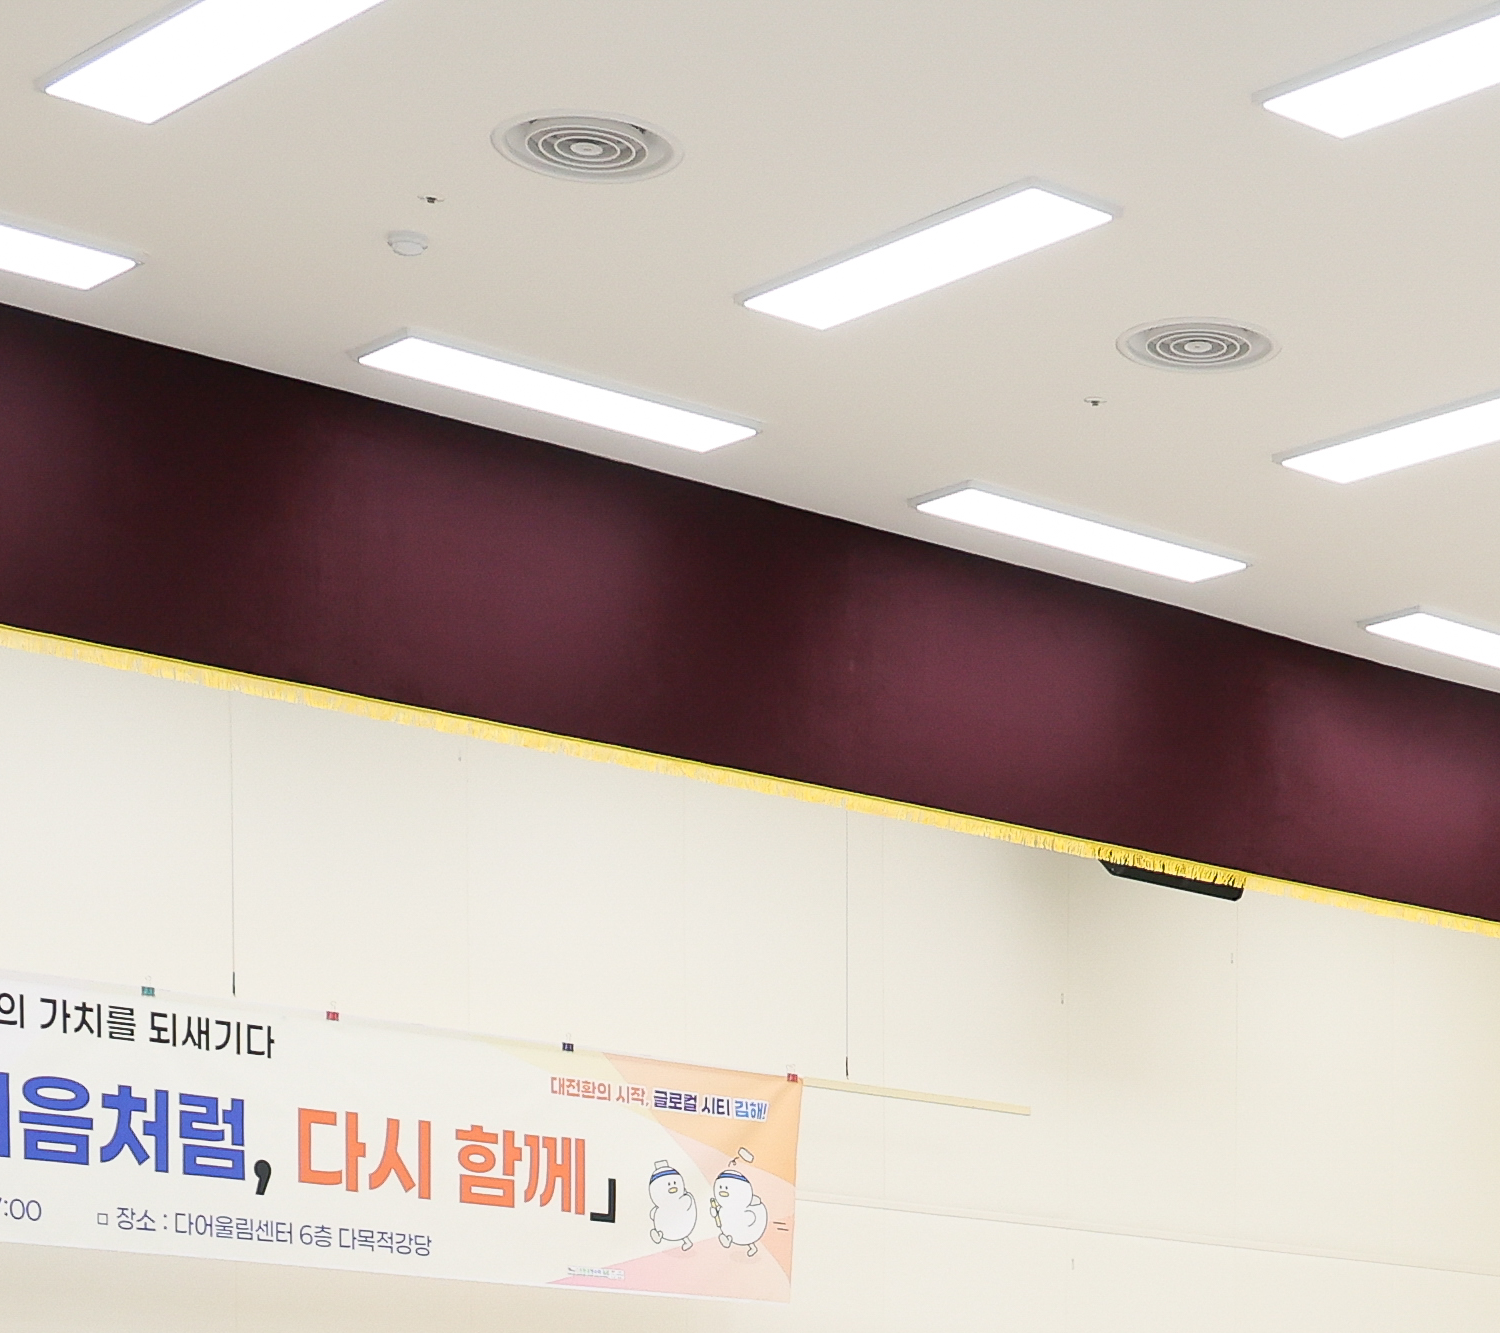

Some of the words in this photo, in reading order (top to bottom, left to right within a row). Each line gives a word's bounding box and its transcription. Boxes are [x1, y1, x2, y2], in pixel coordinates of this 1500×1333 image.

[40, 997, 137, 1042] 가치를
[149, 1011, 276, 1059] 되새기다
[550, 1076, 611, 1102] 대전환의
[653, 1089, 698, 1113] 글로컬
[701, 1096, 731, 1116] 시티
[734, 1100, 767, 1121] 김해!
[297, 1107, 432, 1200] 다시
[116, 1207, 157, 1232] 장소
[174, 1212, 294, 1245] 다어울림센터
[299, 1224, 333, 1249] 6층
[338, 1227, 433, 1257] 다목적강당
